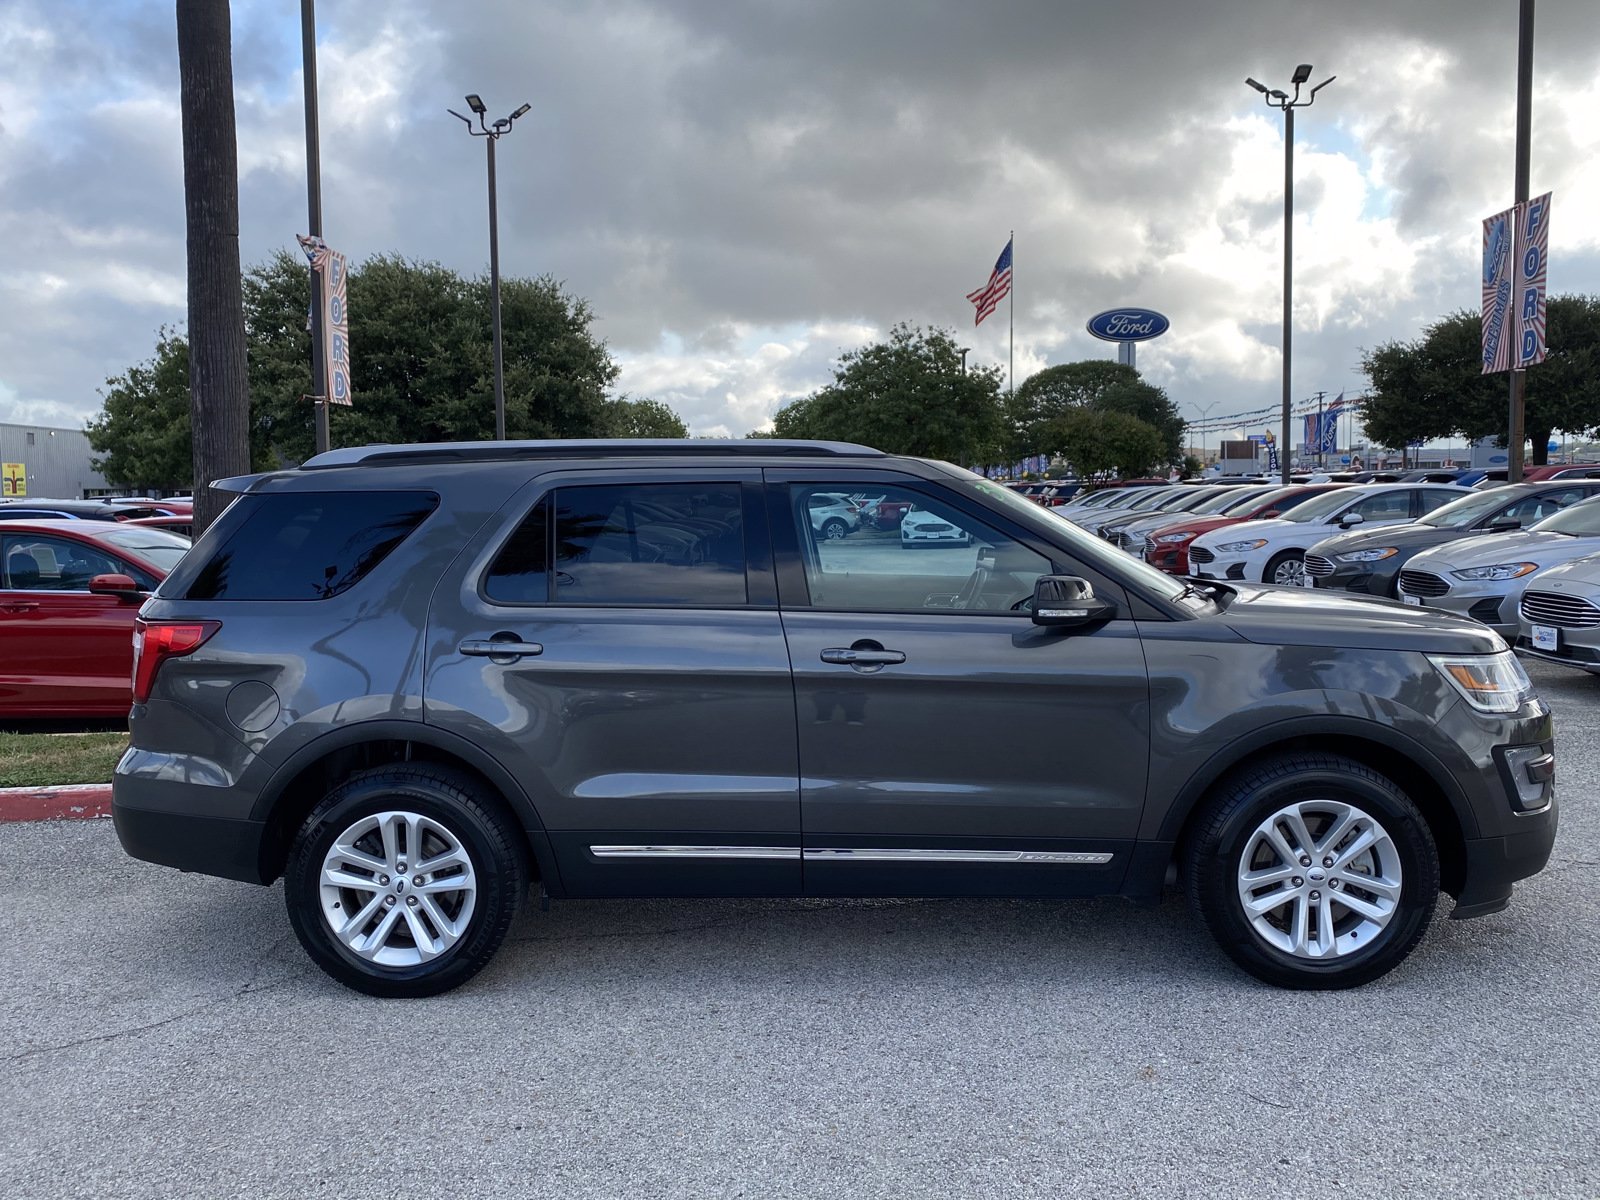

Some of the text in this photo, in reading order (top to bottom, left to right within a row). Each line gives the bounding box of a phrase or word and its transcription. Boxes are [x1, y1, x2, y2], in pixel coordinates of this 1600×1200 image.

[331, 258, 345, 398] FORD
[1106, 314, 1154, 334] Ford
[1522, 204, 1541, 361] FORD
